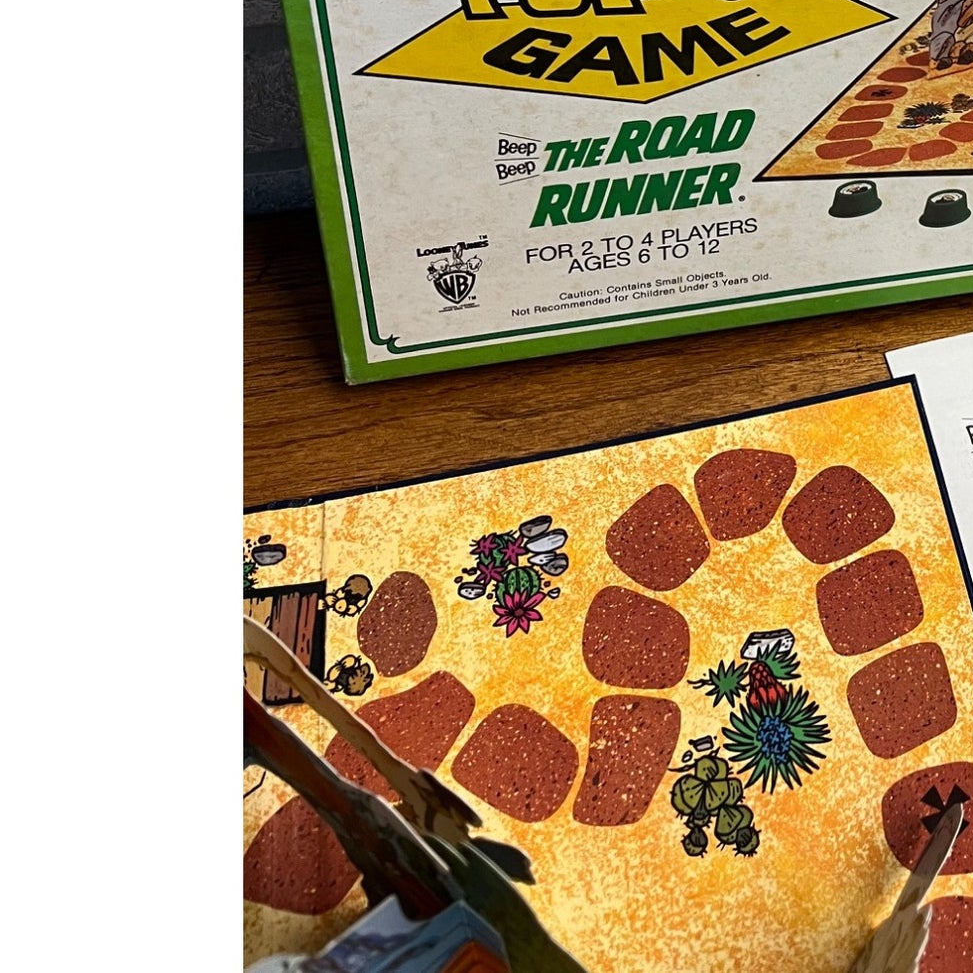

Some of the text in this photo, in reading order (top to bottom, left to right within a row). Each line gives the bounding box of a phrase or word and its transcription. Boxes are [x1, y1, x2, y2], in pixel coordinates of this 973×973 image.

[482, 6, 791, 86] GAME
[498, 139, 537, 156] Beep
[543, 109, 756, 172] THE ROAD
[496, 160, 536, 180] Beep
[526, 217, 758, 264] FOR 2 TO 4 PLAYERS
[568, 239, 720, 274] AGES 6 TO 12
[440, 274, 469, 300] WB
[511, 272, 772, 317] Not Recommended for Children Under 3 Years Old.
[559, 270, 727, 301] Caution: Contains Small Objects.
